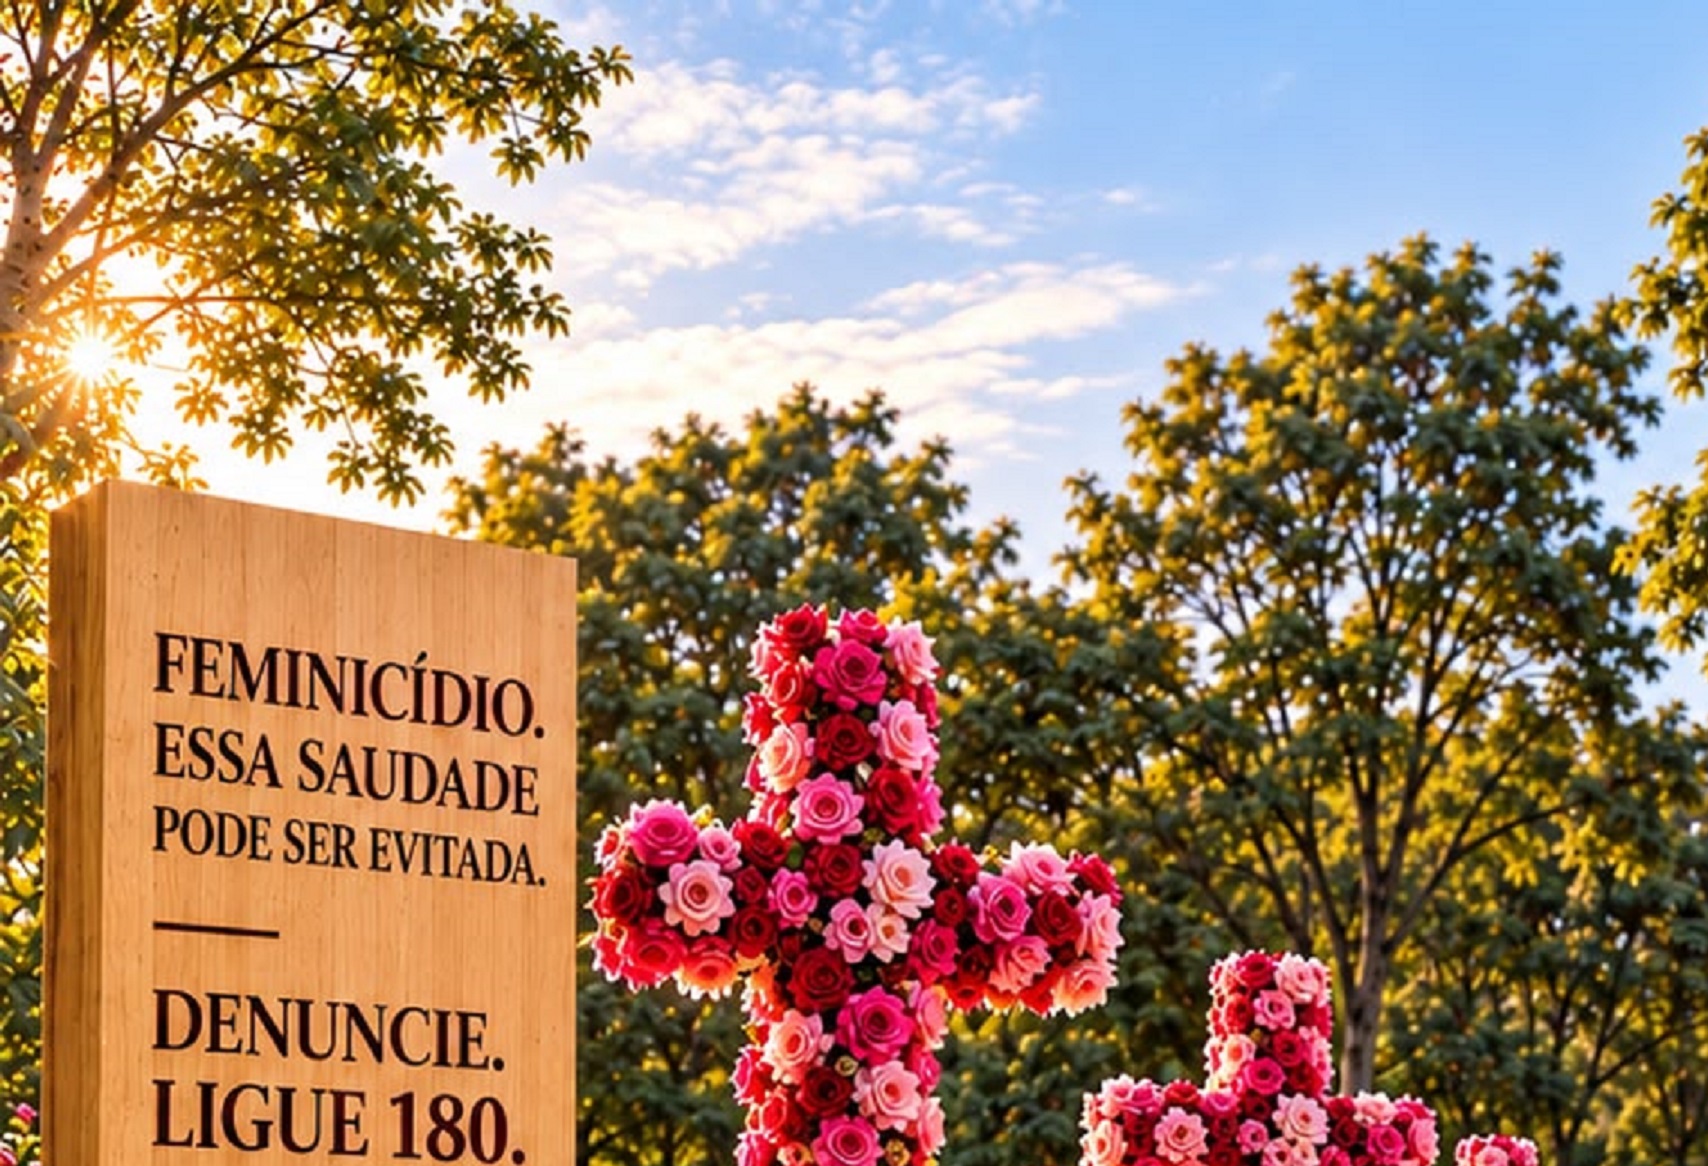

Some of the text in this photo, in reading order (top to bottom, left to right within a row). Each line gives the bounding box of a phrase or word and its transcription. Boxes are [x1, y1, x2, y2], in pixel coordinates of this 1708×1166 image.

[153, 631, 545, 739] FEMINICÍDIO.
[153, 722, 540, 817] ESSA SAUDADE
[153, 805, 546, 887] PODE SER EVITADA.
[152, 988, 505, 1072] DENUNCIE.
[152, 1079, 526, 1166] LIGUE 180.
